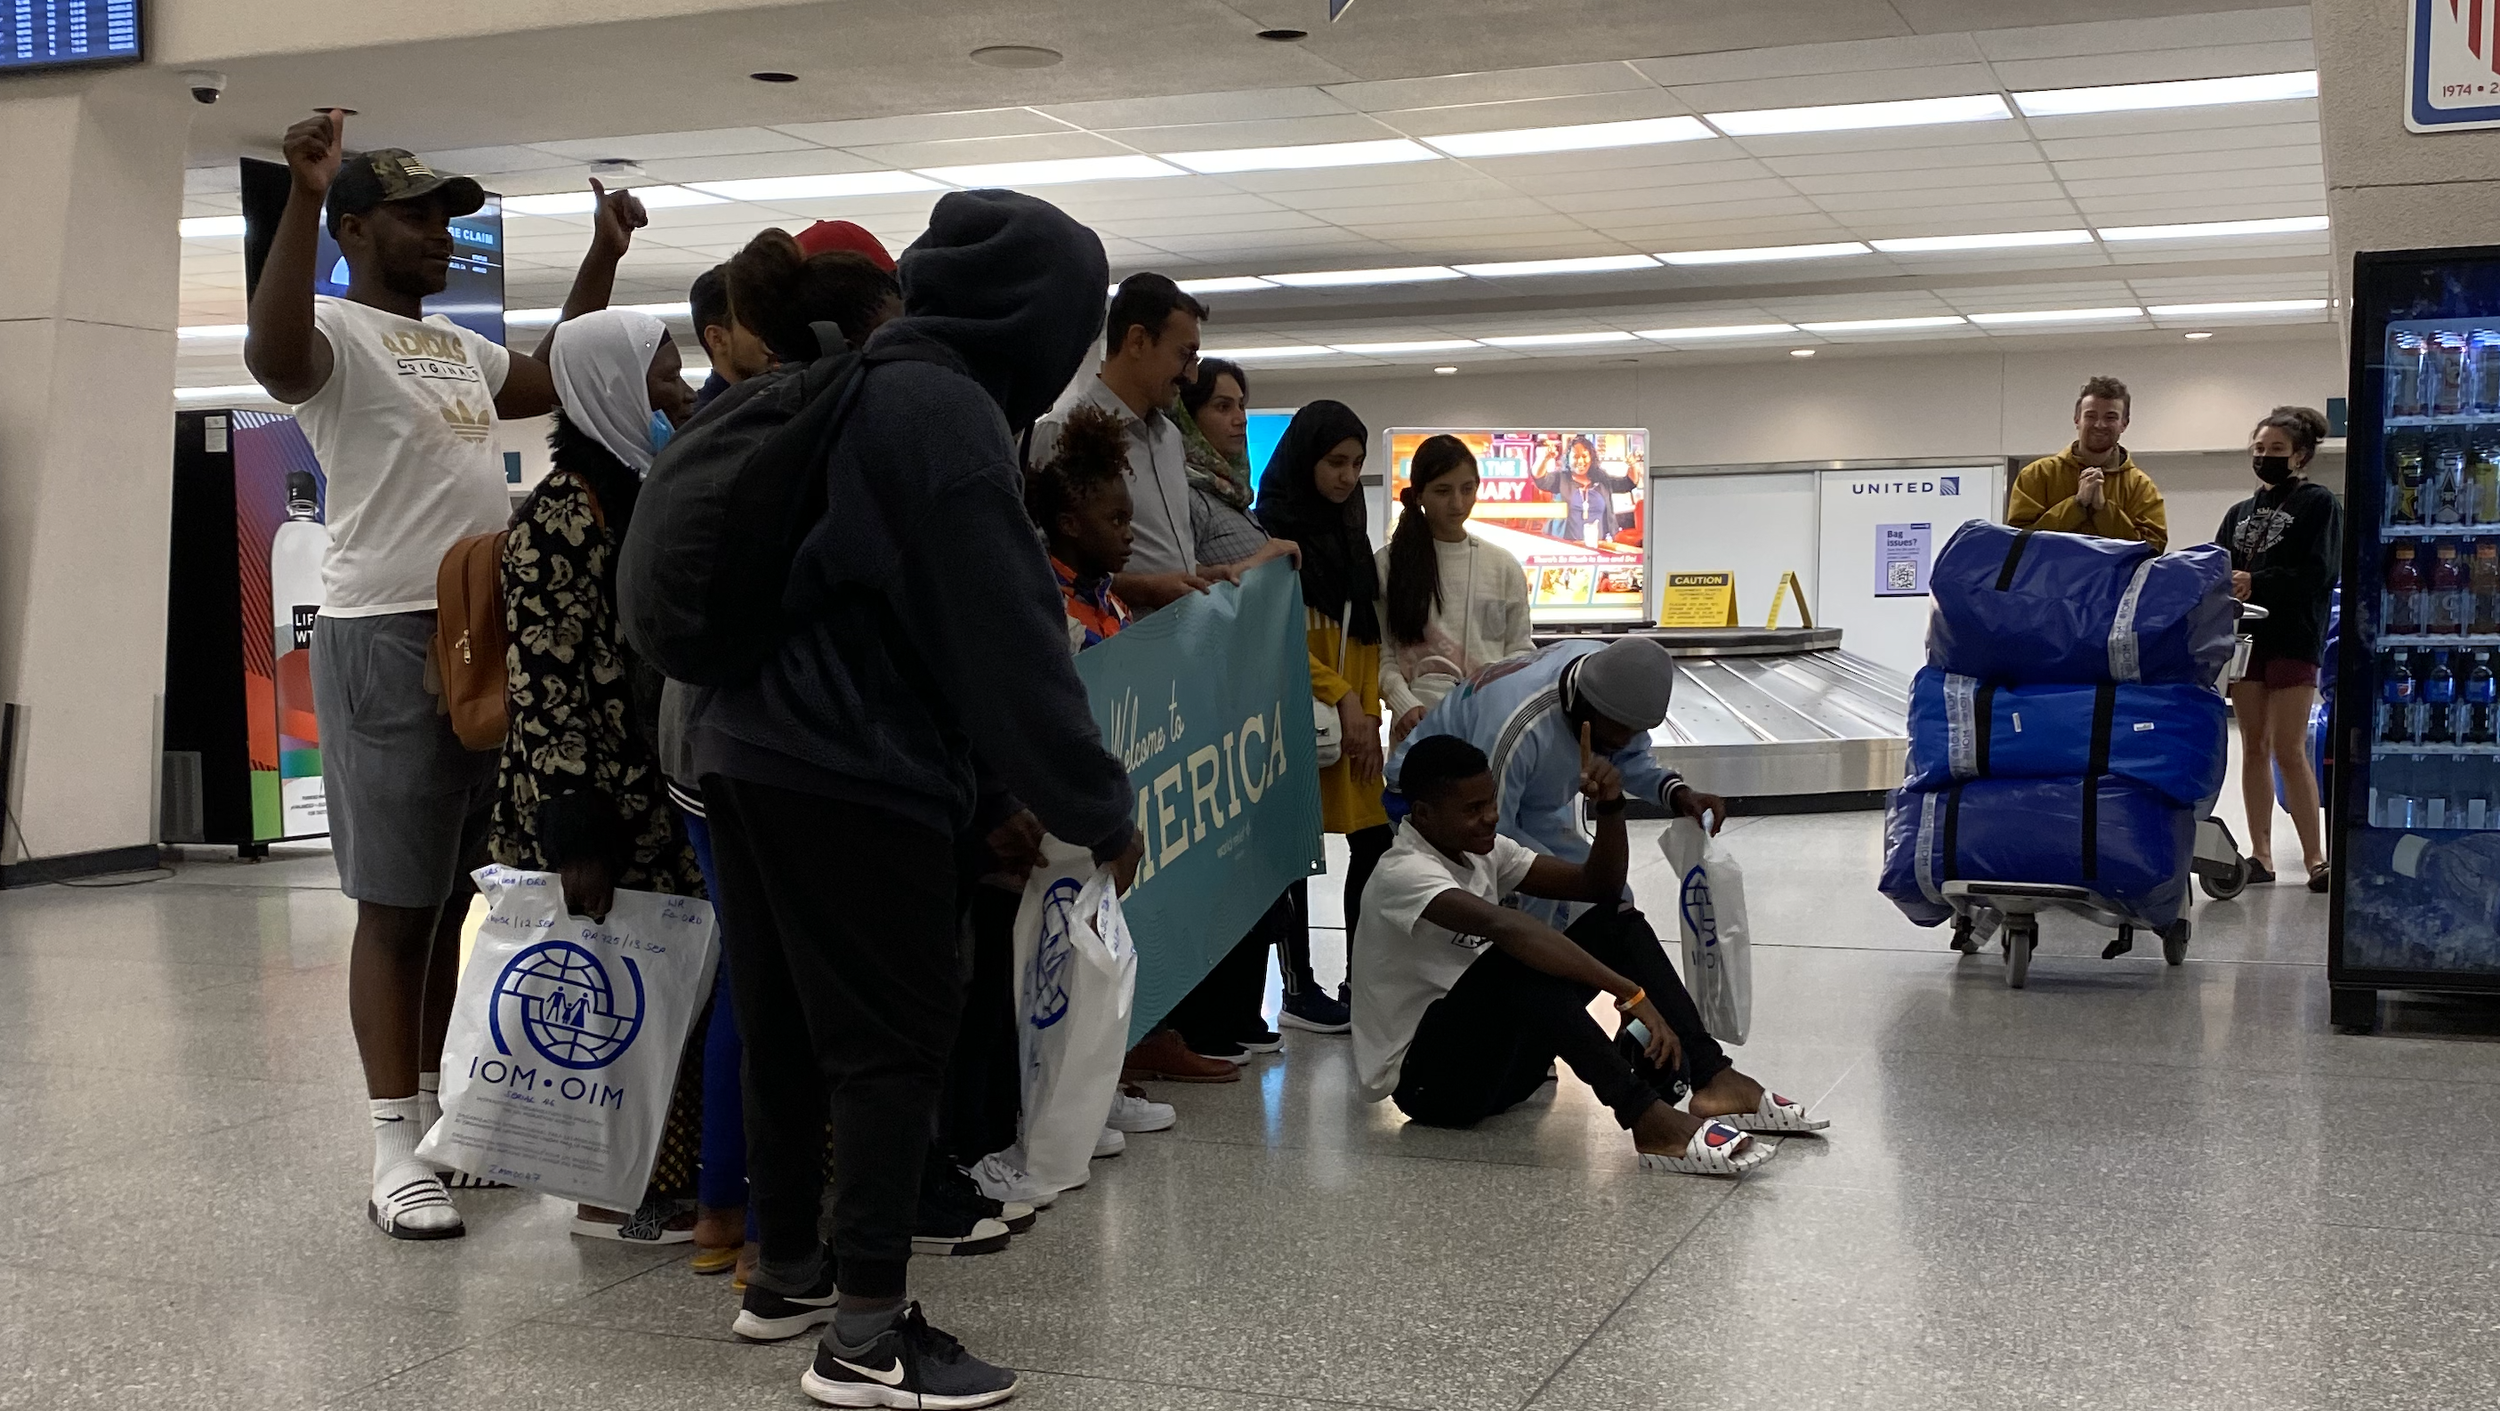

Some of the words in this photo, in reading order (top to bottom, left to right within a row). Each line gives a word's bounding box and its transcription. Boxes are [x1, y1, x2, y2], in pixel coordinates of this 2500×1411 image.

[2442, 84, 2472, 98] 1974
[2490, 82, 2500, 94] 2
[463, 229, 494, 245] CLAIM
[381, 330, 467, 365] ADIDAS
[1485, 461, 1516, 477] THE
[1852, 482, 1934, 495] UNITED
[1887, 530, 1903, 539] Bag
[1887, 538, 1917, 547] issues?
[1674, 576, 1723, 585] CAUTION
[295, 613, 317, 626] LIF
[1109, 685, 1166, 775] Welcome
[1168, 679, 1184, 743] to
[468, 1056, 537, 1091] IOM
[561, 1077, 625, 1110] OIM
